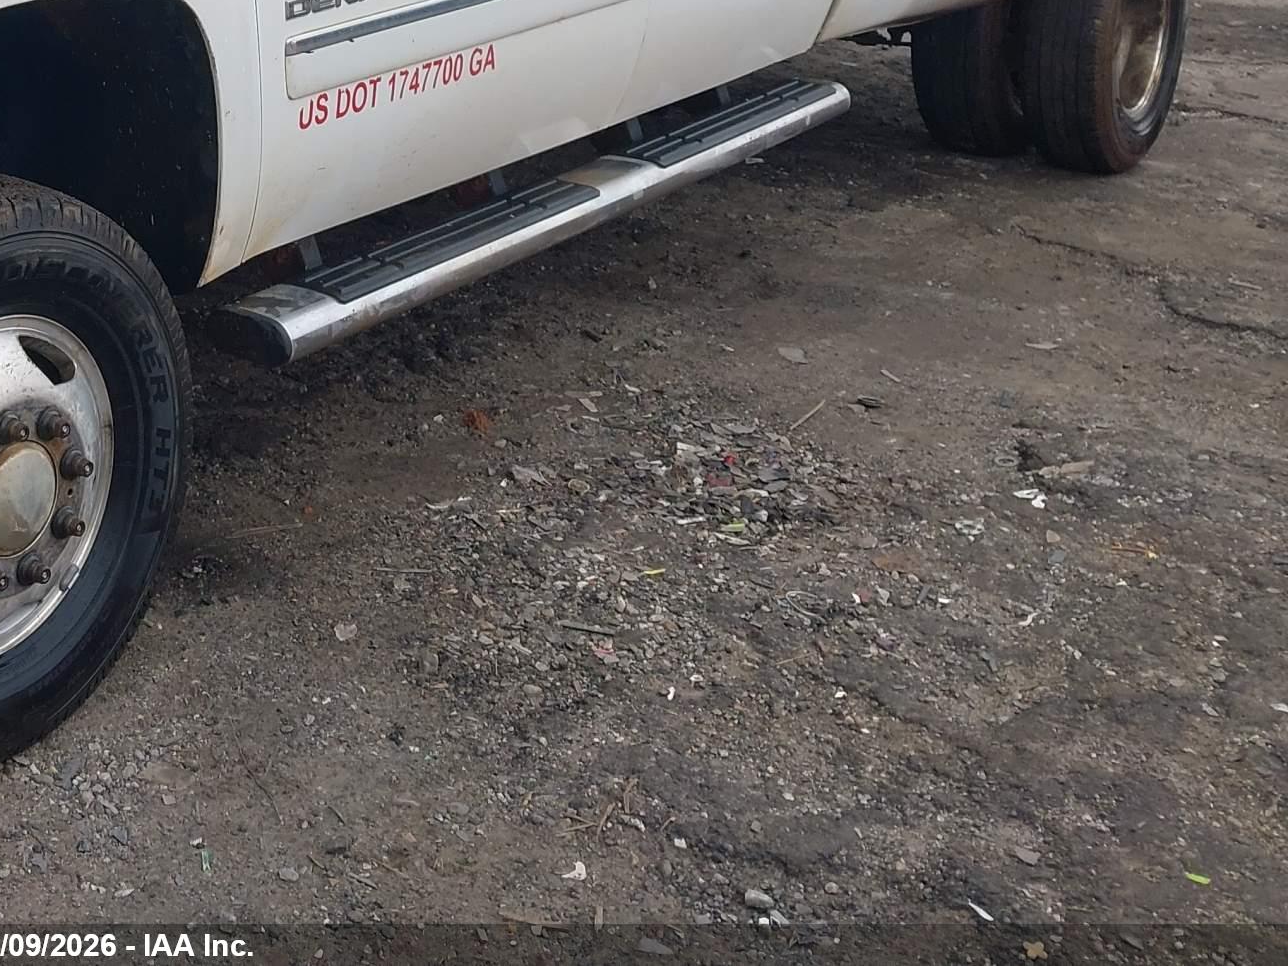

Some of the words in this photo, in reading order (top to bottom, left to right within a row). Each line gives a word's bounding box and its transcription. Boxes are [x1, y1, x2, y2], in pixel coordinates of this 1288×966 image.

[298, 92, 329, 131] US
[335, 75, 383, 120] DOT
[388, 52, 464, 103] 1747700
[468, 43, 497, 76] GA
